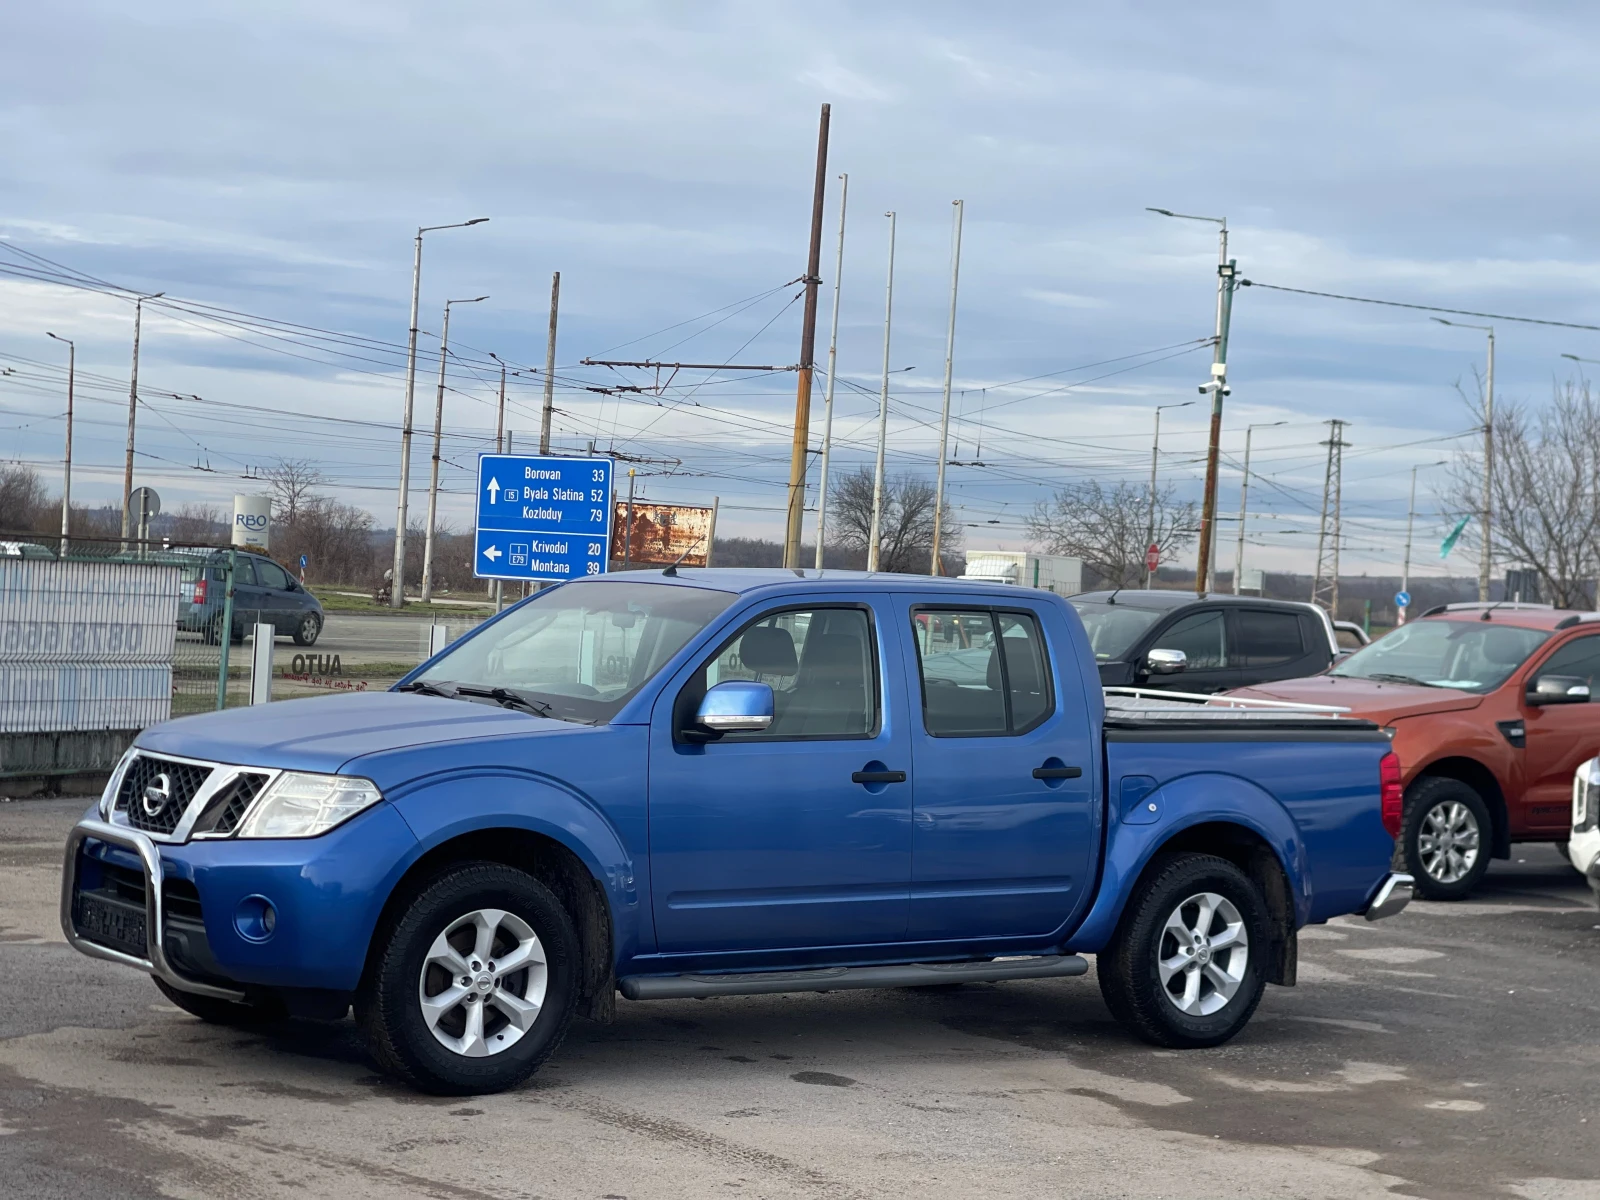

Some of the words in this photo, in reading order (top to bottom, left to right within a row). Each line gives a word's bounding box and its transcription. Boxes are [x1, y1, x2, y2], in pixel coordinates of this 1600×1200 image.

[524, 466, 561, 480] Borovan
[592, 469, 605, 482] 33
[523, 486, 549, 502] Byala
[552, 487, 584, 501] Slatina
[590, 489, 604, 502] 52
[236, 513, 267, 531] RBO
[522, 505, 563, 523] Kozloduy
[589, 508, 603, 522] 79
[532, 540, 568, 554] Krivodol
[587, 542, 601, 556] 20
[512, 555, 524, 564] E79
[531, 558, 570, 574] Montana
[586, 561, 600, 575] 39
